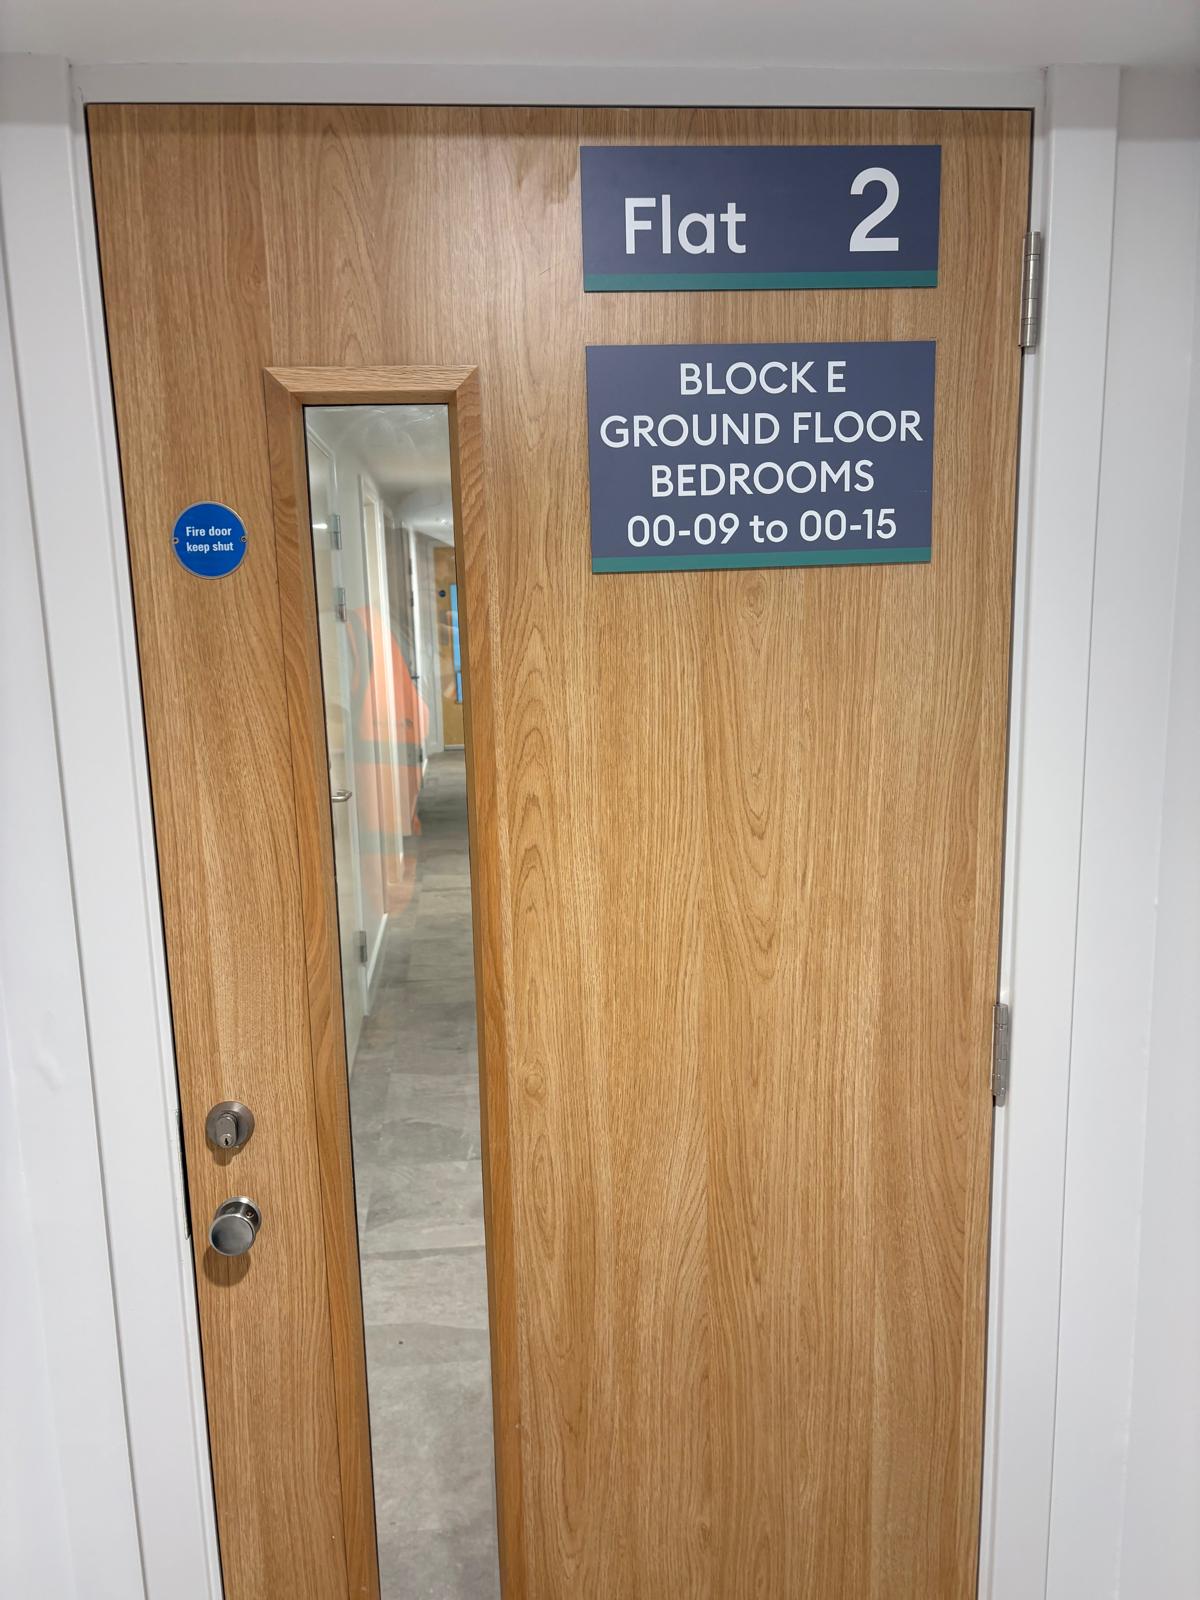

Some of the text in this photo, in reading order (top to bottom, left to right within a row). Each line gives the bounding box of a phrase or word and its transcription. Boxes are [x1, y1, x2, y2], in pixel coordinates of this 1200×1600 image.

[625, 167, 899, 254] Flat 2
[680, 361, 846, 395] BLOCK E
[600, 411, 923, 448] GROUND FLOOR
[652, 460, 874, 497] BEDROOMS
[186, 526, 231, 536] Fire door
[628, 509, 896, 547] 00-09 to 00-15
[186, 541, 234, 554] keep shut
